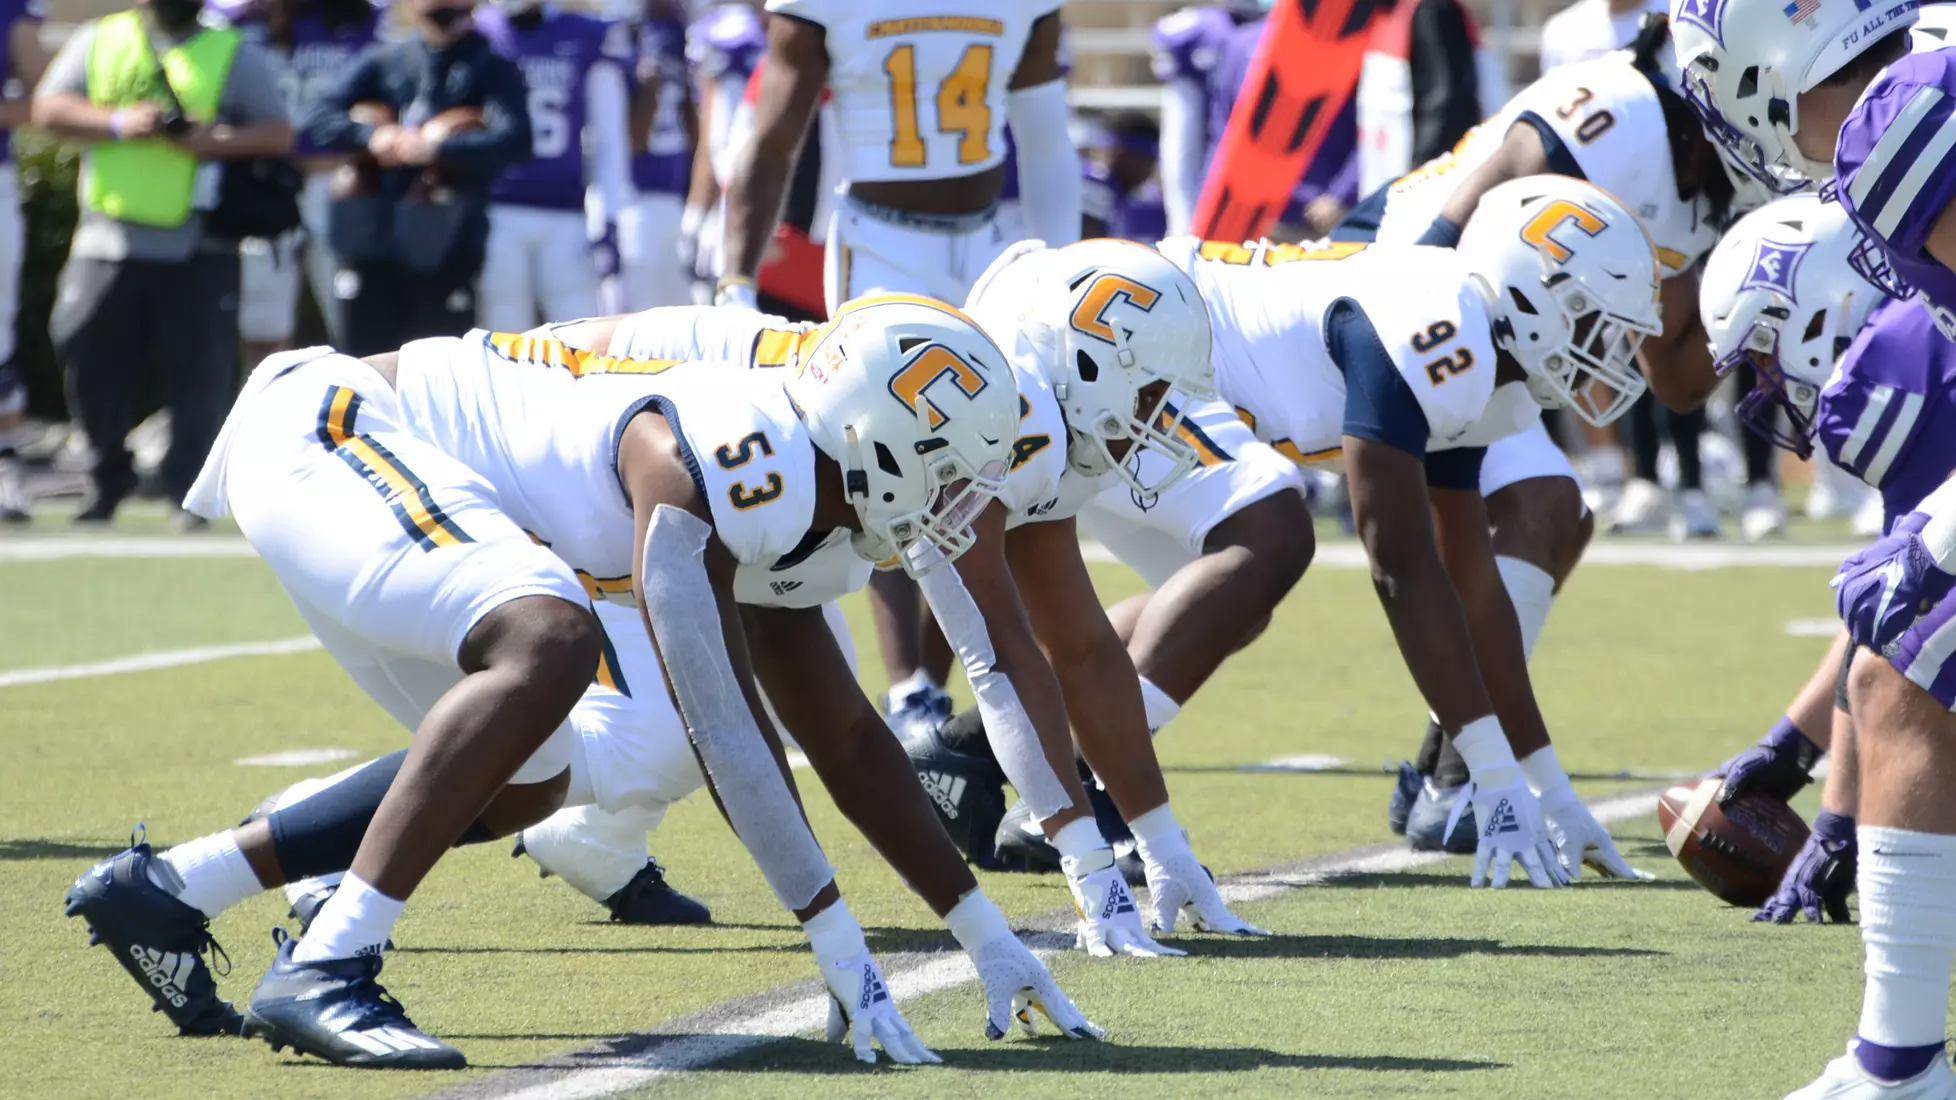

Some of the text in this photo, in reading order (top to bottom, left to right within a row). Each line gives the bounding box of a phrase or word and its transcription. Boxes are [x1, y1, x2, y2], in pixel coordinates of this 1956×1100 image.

[1842, 30, 1859, 50] FU
[1862, 16, 1884, 37] ALL
[1885, 3, 1905, 21] THE
[884, 45, 992, 167] 14
[1555, 87, 1616, 145] 30
[1519, 199, 1608, 265] C
[1069, 273, 1162, 346] C
[1410, 319, 1475, 388] 92
[887, 343, 989, 433] C
[714, 430, 785, 512] 53
[918, 771, 959, 820] adidas
[1484, 798, 1509, 837] adidas
[1102, 879, 1119, 920] adidas
[129, 944, 188, 1008] adidas
[860, 963, 873, 1010] adidas
